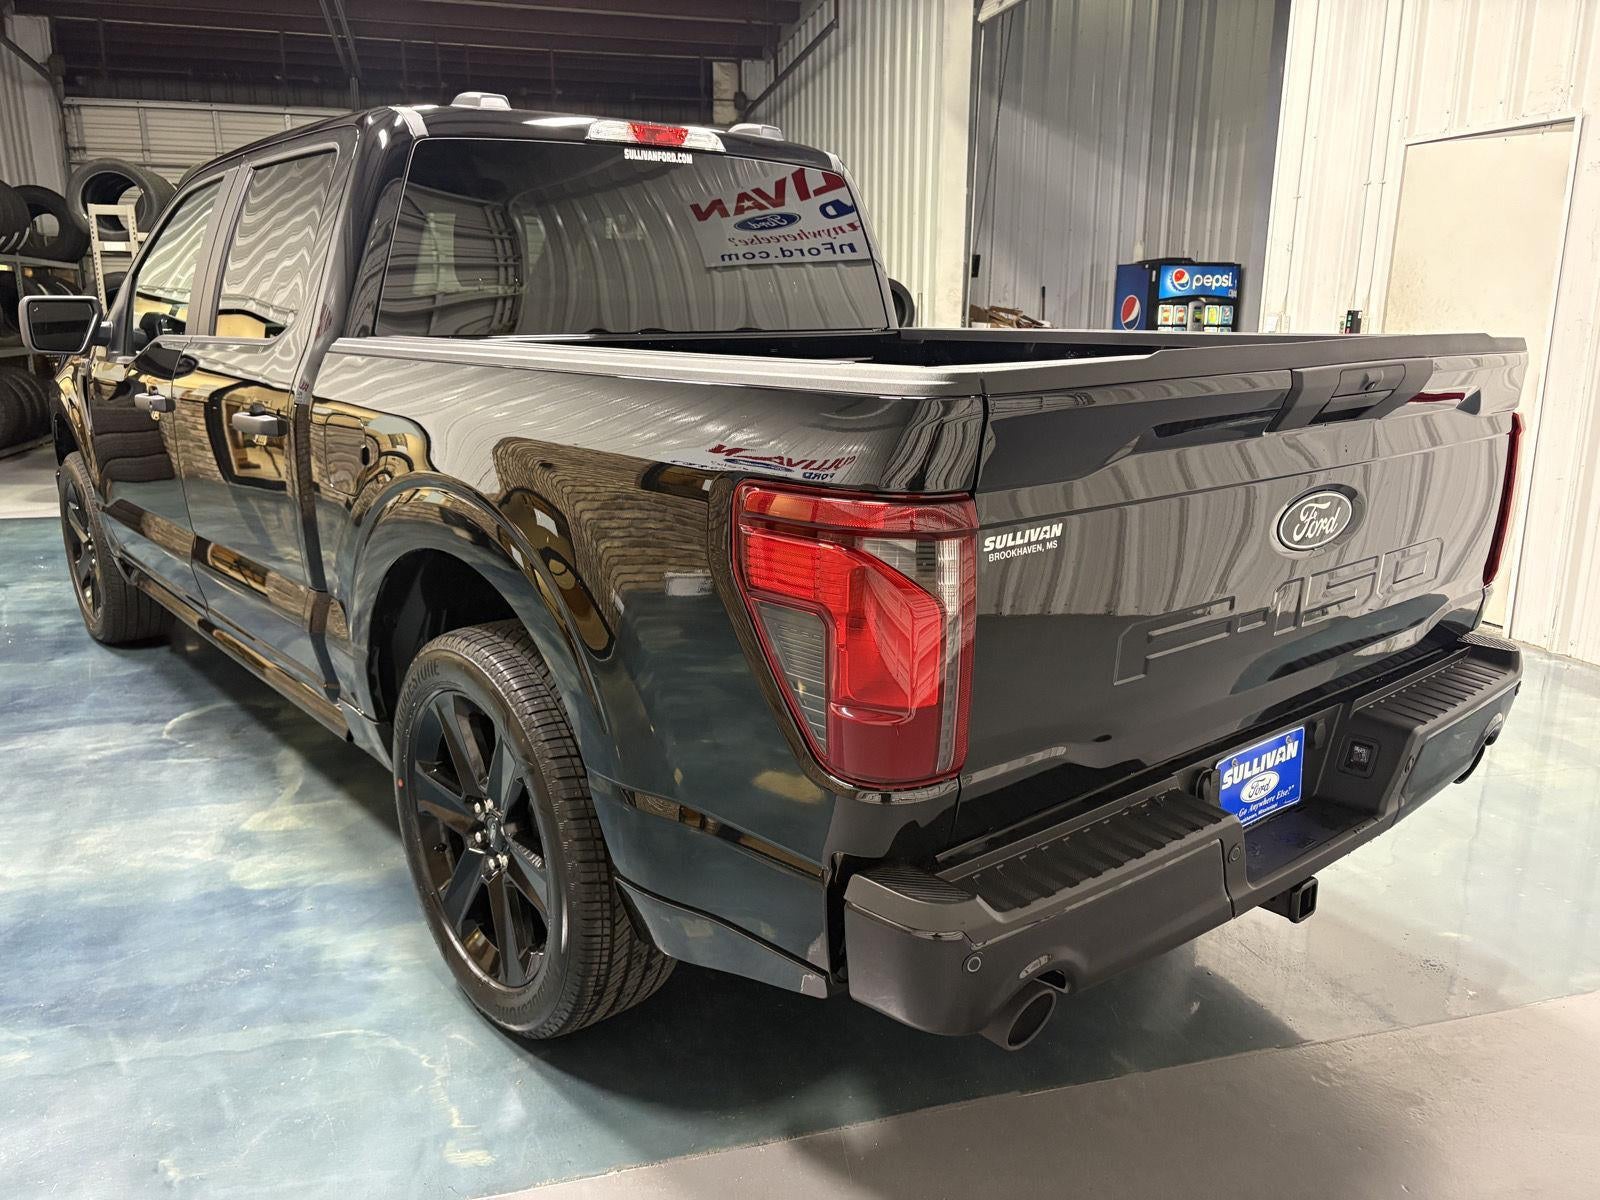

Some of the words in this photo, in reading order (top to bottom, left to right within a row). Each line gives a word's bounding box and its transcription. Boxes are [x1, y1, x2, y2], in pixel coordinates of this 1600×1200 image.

[624, 148, 693, 164] SULLIVANFORD.COM
[1192, 271, 1233, 291] pepsi
[1293, 500, 1340, 542] Ford
[983, 522, 1063, 552] SULLIVAN
[988, 543, 1045, 563] BROOKHAVEN,
[1046, 539, 1058, 551] MS
[1113, 537, 1444, 686] F-150
[1221, 740, 1299, 790] SULLIVAN
